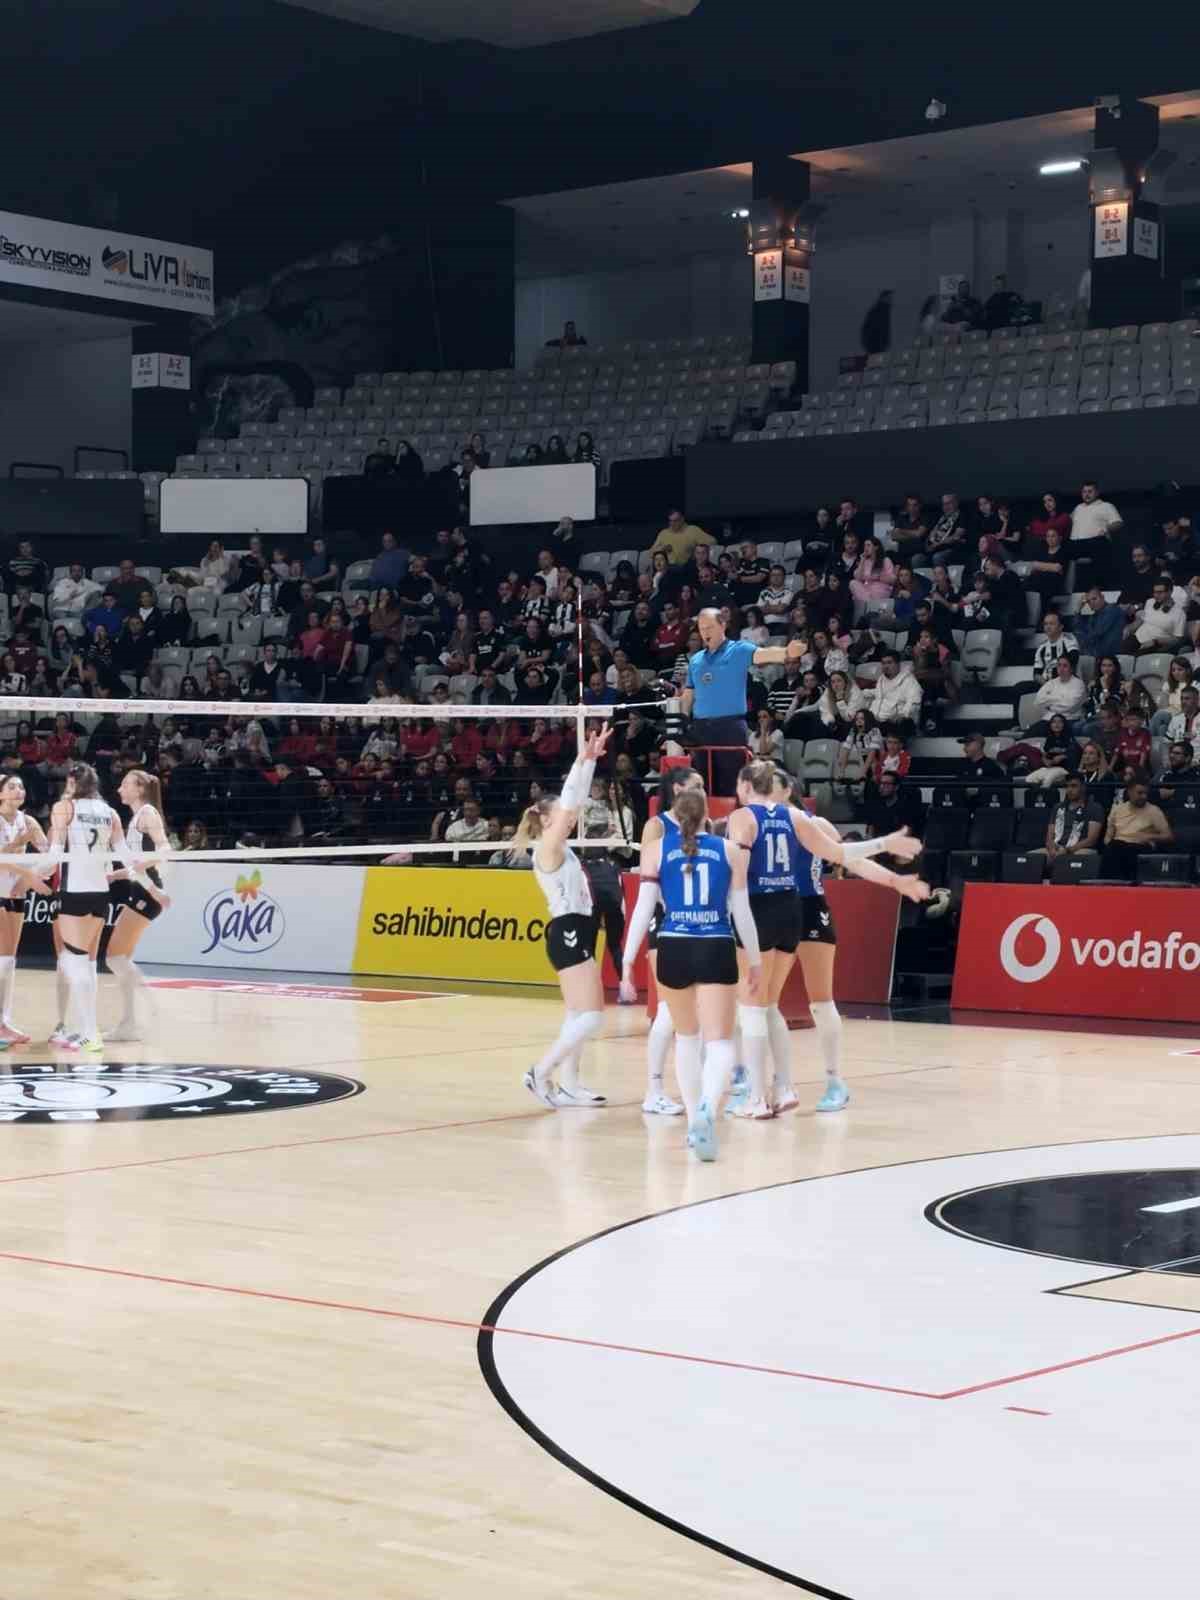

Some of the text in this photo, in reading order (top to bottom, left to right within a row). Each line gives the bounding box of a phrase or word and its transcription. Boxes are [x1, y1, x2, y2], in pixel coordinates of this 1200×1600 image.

[3, 242, 92, 269] SKYVISION
[764, 833, 791, 873] 14
[680, 863, 710, 906] 11
